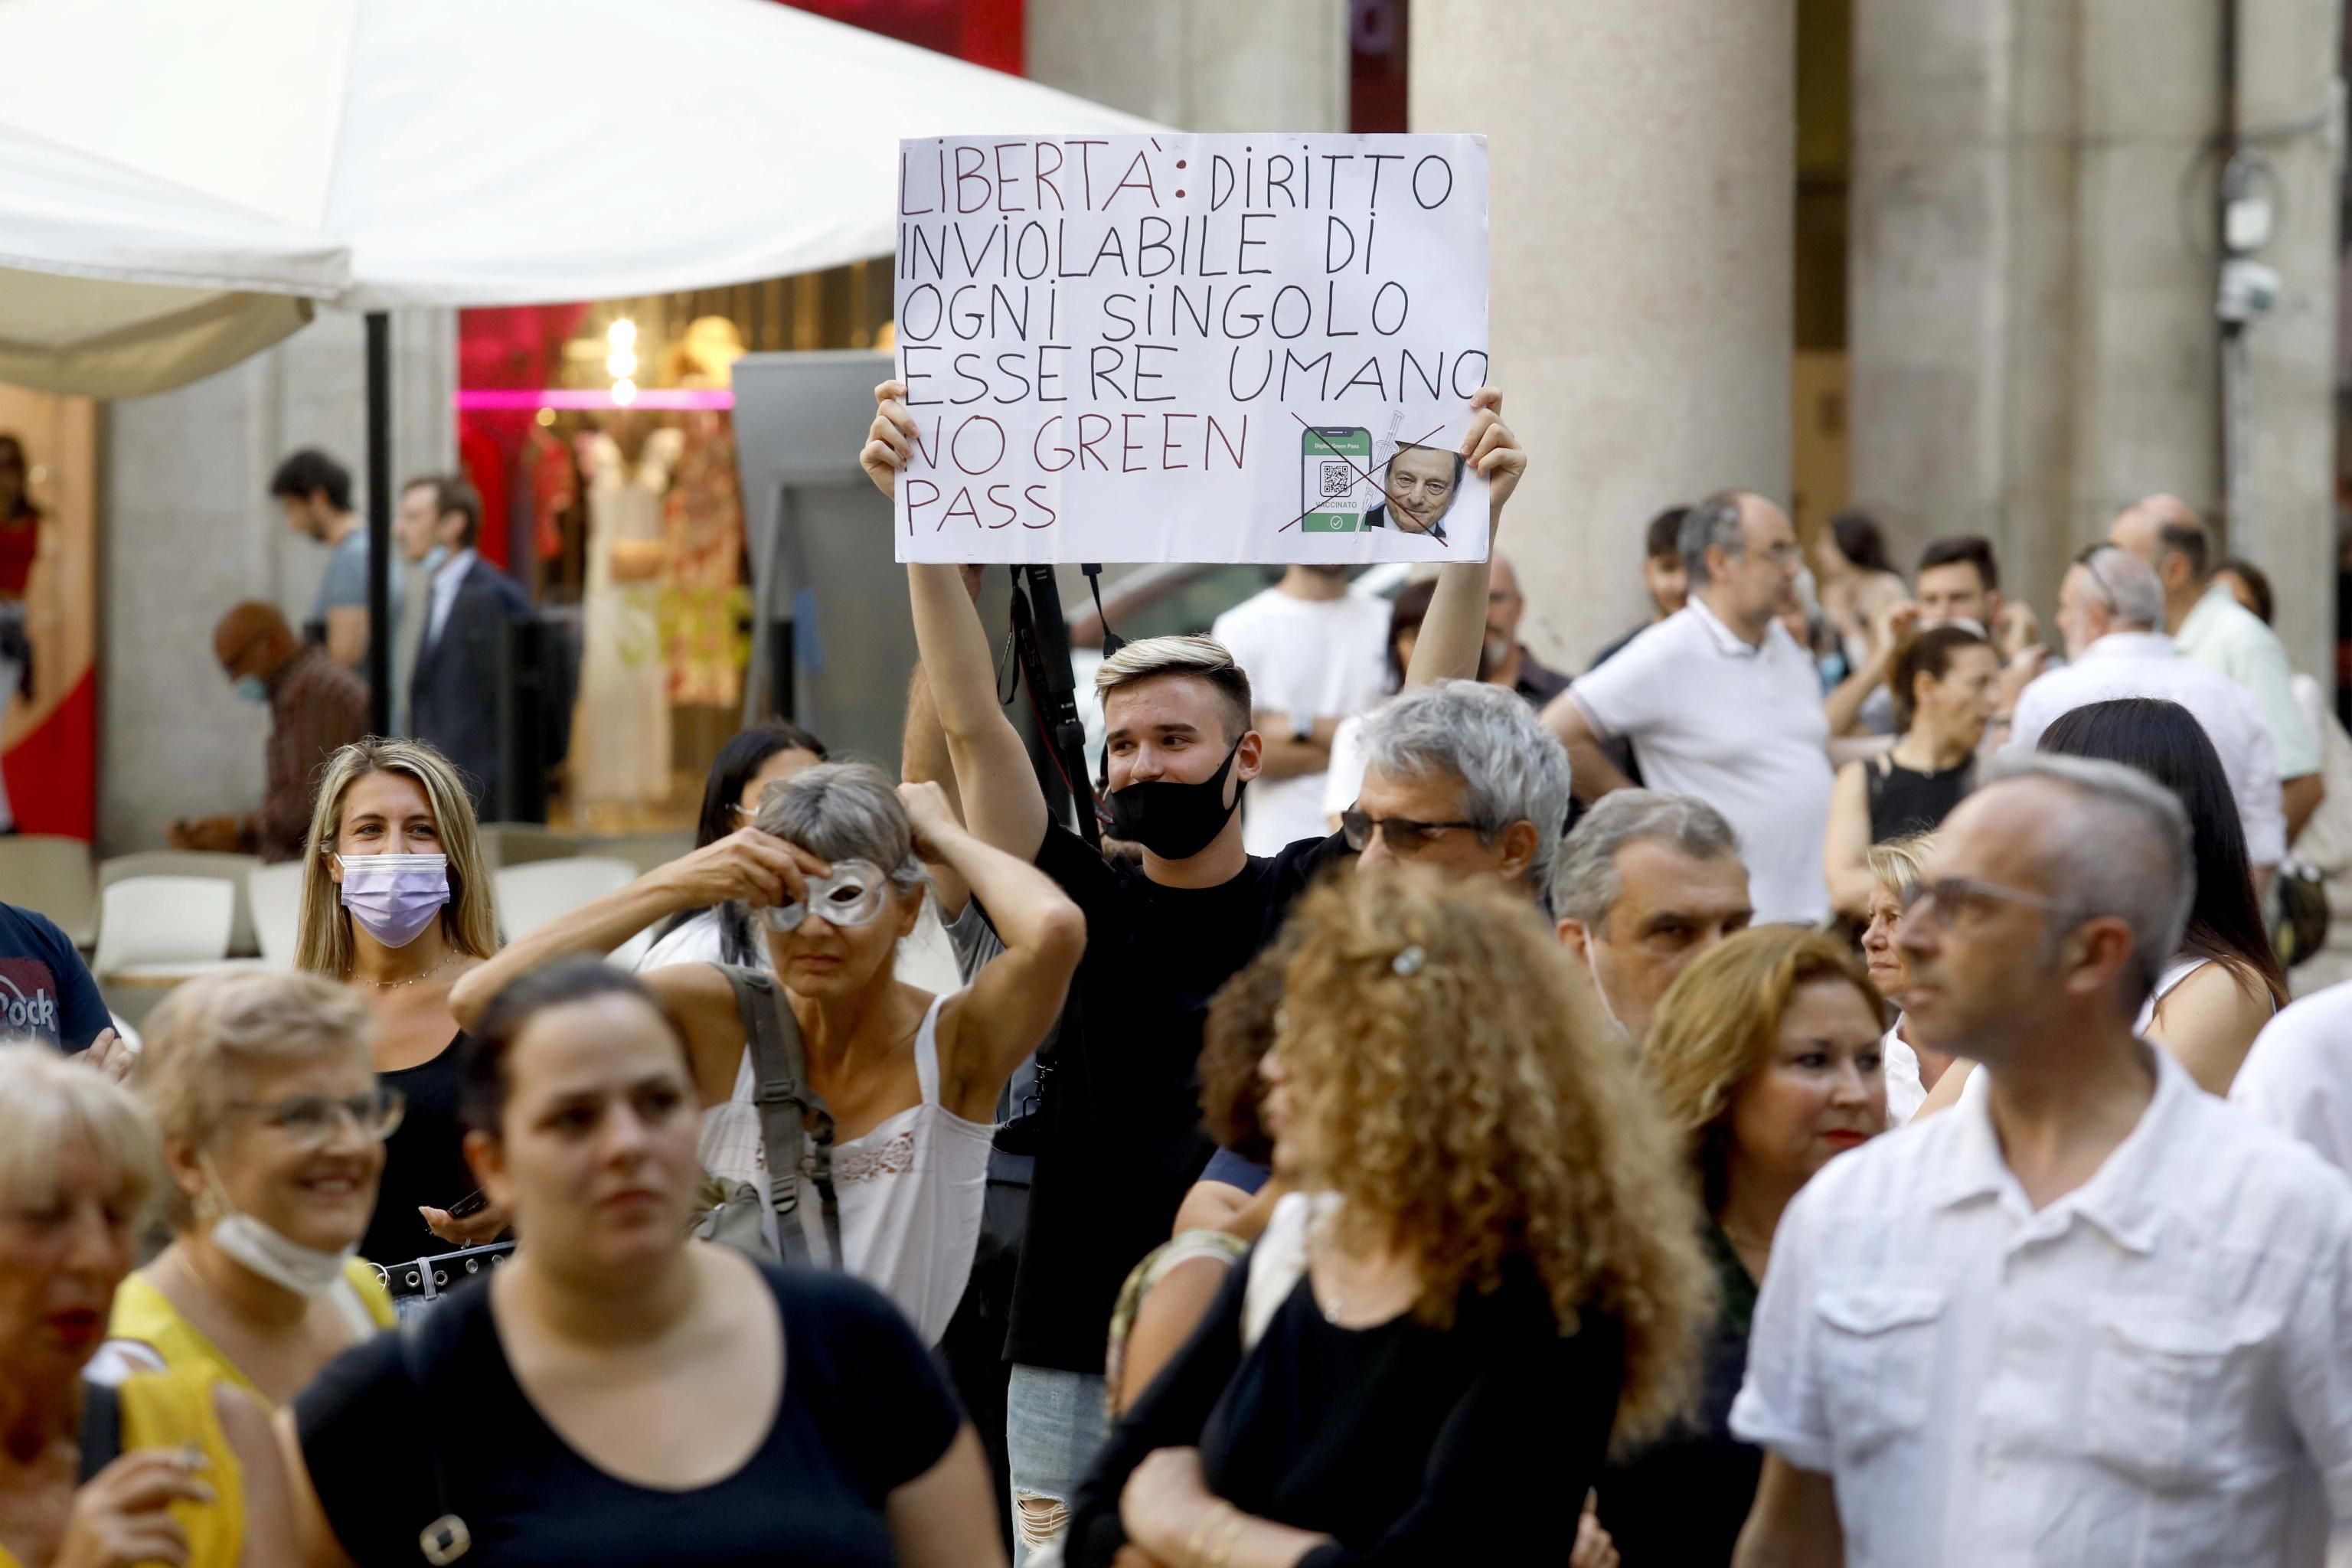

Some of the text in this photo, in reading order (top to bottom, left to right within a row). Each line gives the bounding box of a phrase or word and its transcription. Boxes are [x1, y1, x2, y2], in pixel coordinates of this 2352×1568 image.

[903, 345, 1488, 406] ESSERE UMANO
[1034, 413, 1247, 472] GREEN
[906, 479, 1057, 537] PASS
